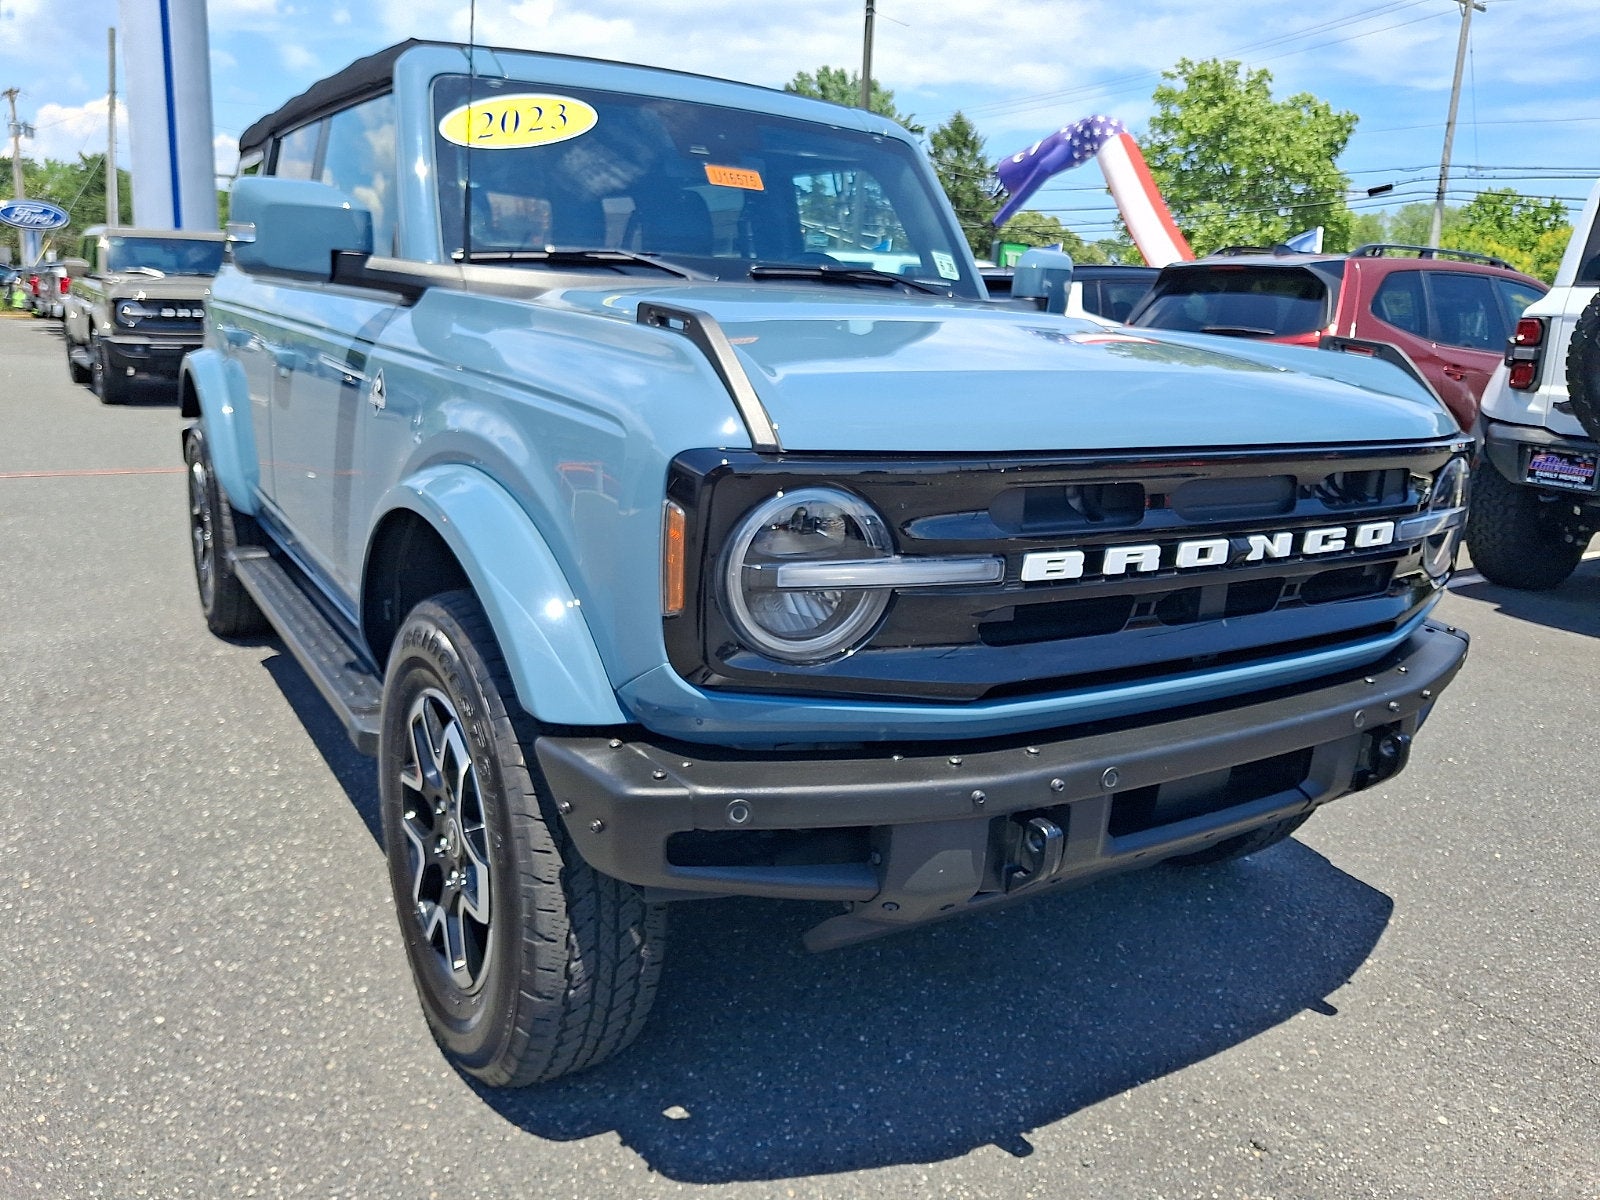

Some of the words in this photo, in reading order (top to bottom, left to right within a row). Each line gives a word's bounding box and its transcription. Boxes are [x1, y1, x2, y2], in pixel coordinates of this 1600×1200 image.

[477, 103, 568, 139] 2023
[10, 206, 56, 226] Ford
[1020, 520, 1395, 582] BRONCO
